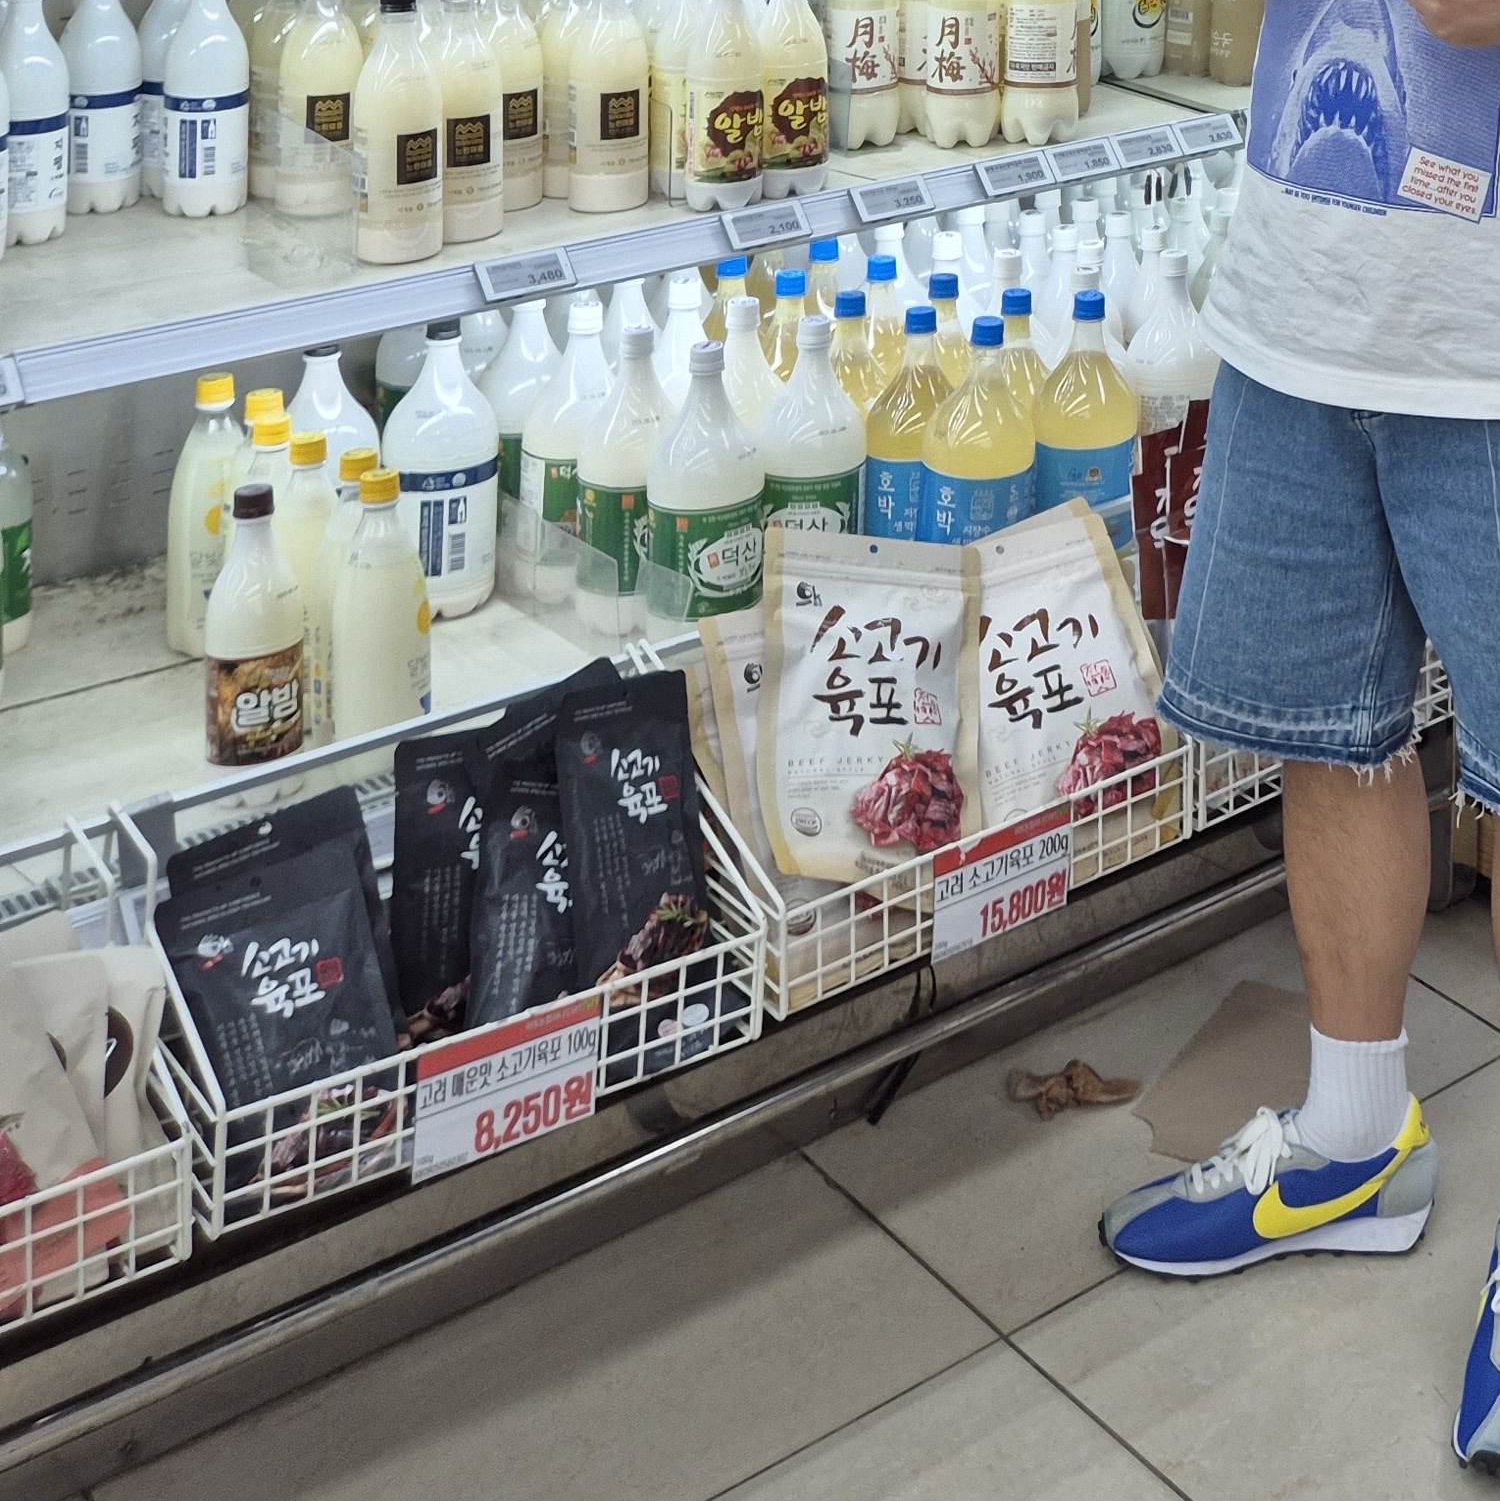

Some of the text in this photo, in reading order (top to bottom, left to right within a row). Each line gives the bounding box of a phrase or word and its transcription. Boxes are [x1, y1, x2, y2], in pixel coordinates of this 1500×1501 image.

[845, 16, 881, 84] 月梅
[933, 16, 966, 83] 月梅
[1413, 166, 1480, 194] missed the first
[1419, 156, 1480, 183] See what you
[1401, 184, 1478, 216] closed your eyes.
[1459, 193, 1477, 204] you
[769, 220, 801, 235] 2,100
[877, 472, 896, 520] 호박
[936, 485, 956, 536] 호박
[720, 538, 758, 566] 덕산
[811, 604, 942, 671] 소고기
[979, 608, 1099, 673] 소고기
[812, 666, 909, 738] 육포
[987, 663, 1085, 730] 육포
[610, 748, 661, 783] 소고기
[788, 756, 884, 767] BEEF JERKY
[985, 740, 1071, 779] BEEF JERKY
[617, 782, 669, 823] 육포
[936, 871, 964, 903] 고려
[1039, 832, 1070, 861] 200g
[980, 868, 1067, 939] 15,800원
[242, 938, 319, 978] 소고기
[252, 974, 325, 1018] 육포
[419, 1076, 447, 1110] 고려
[451, 1063, 494, 1097] 매운맛
[567, 1026, 597, 1056] 100g
[474, 1070, 593, 1154] 8,250원
